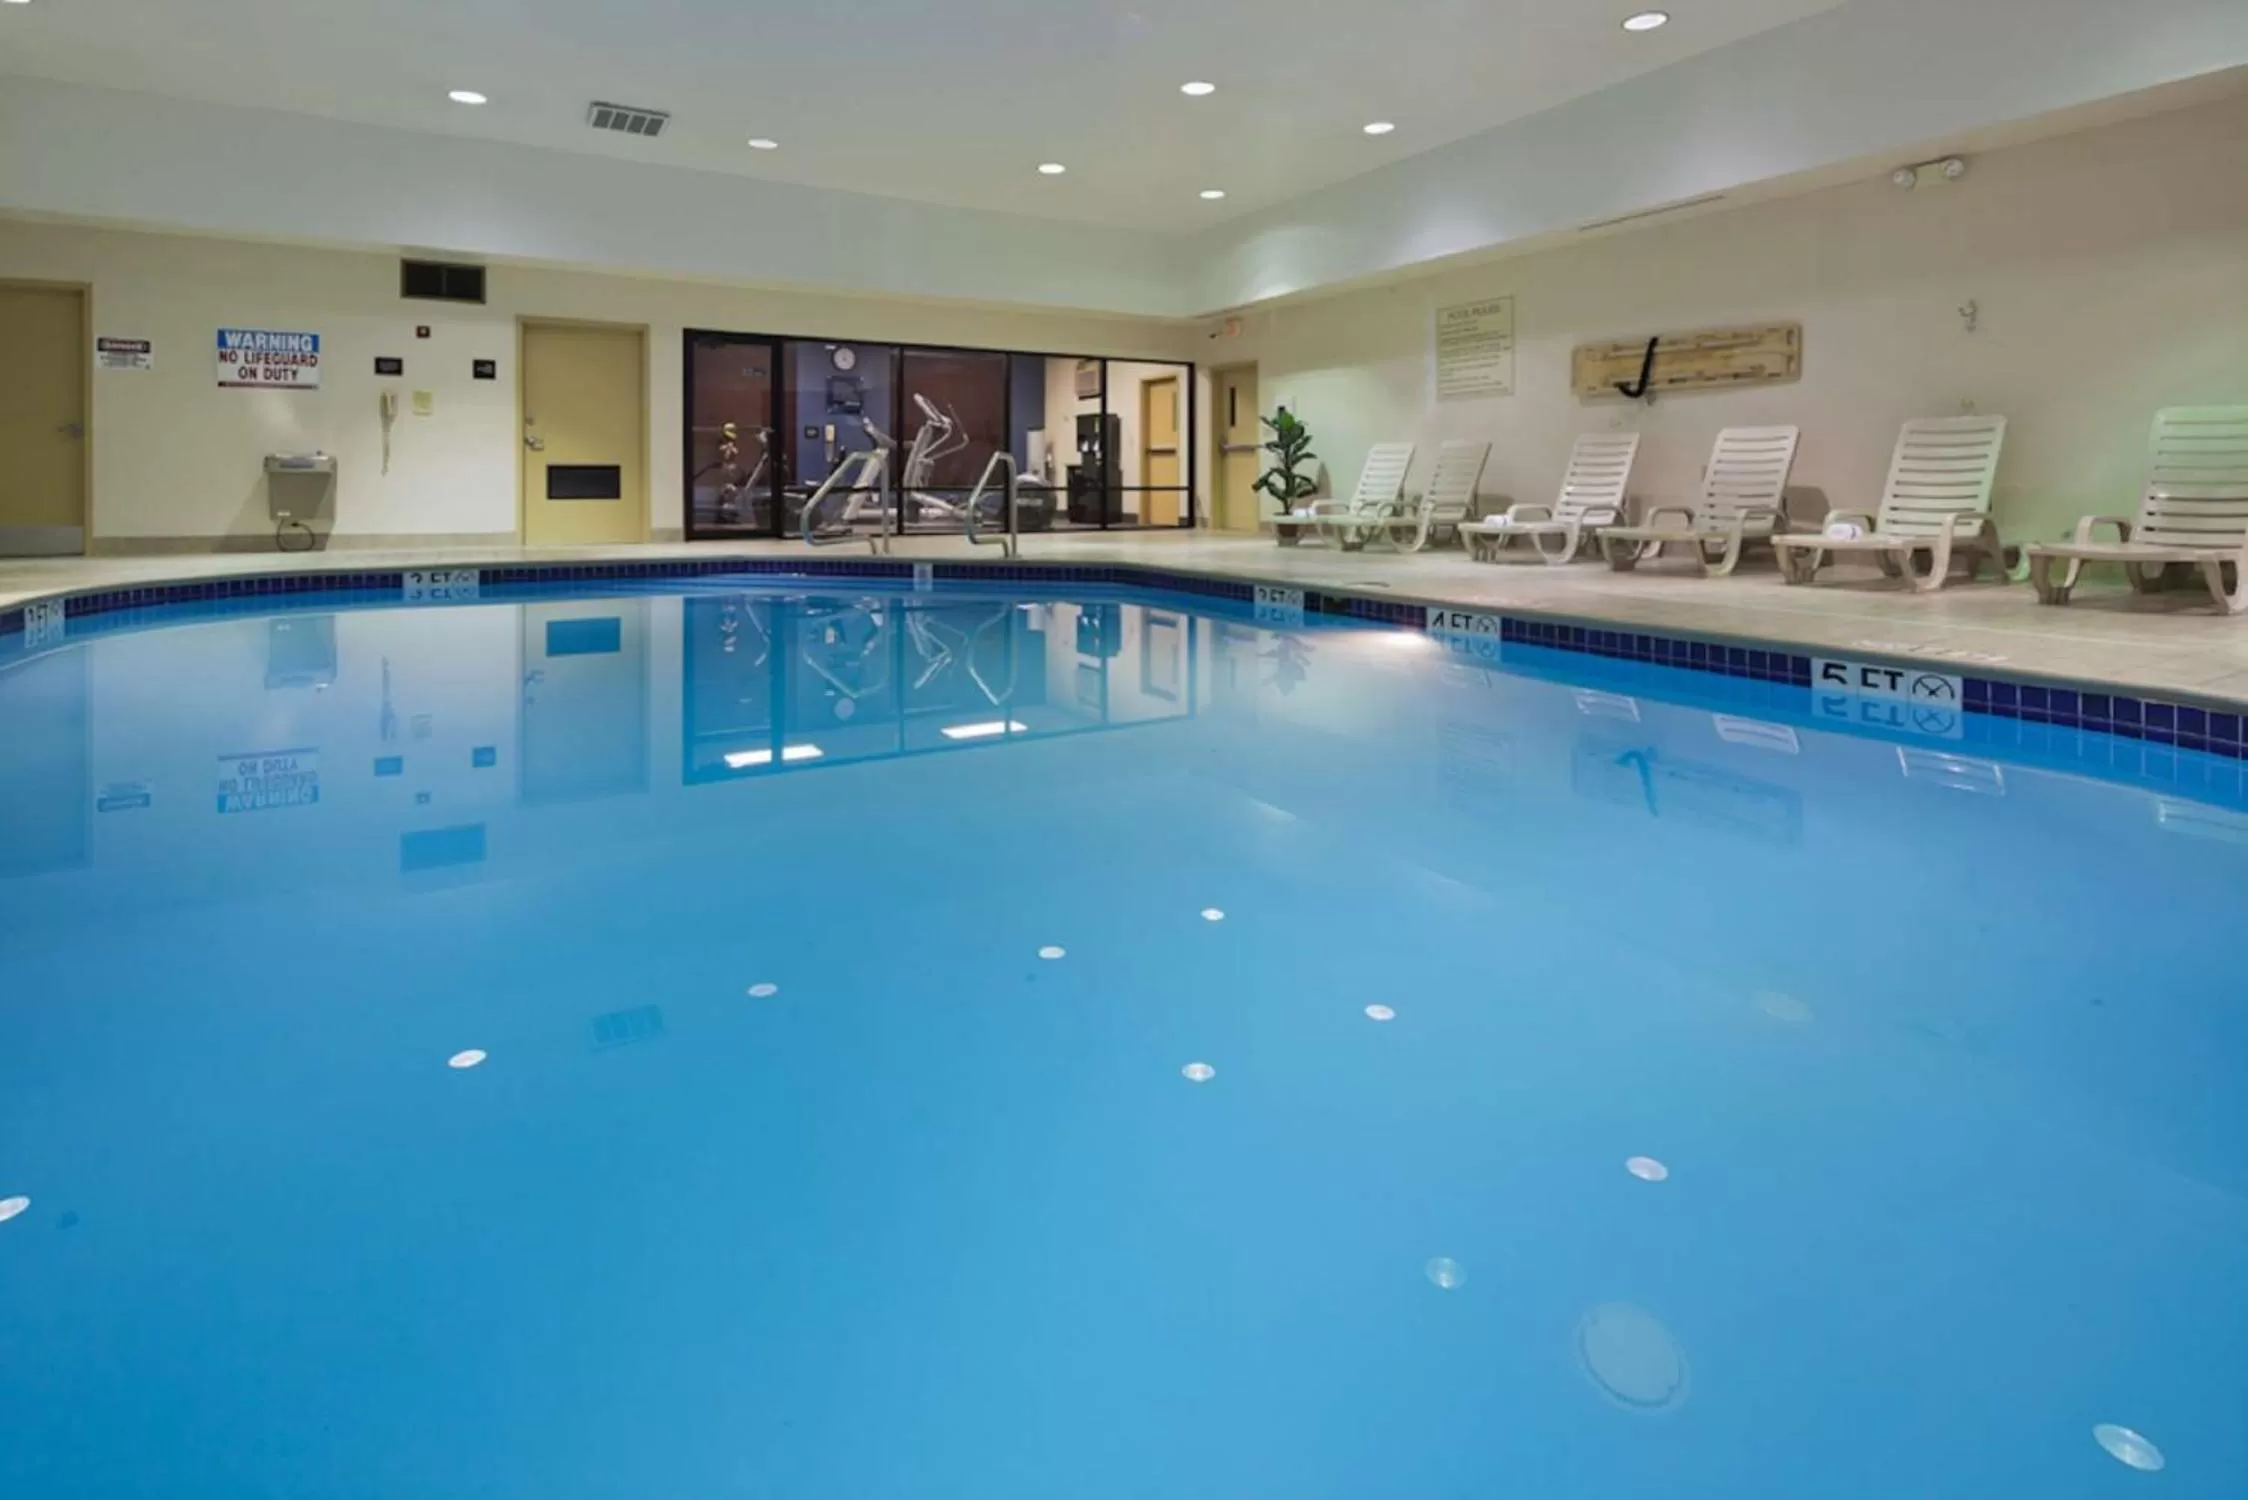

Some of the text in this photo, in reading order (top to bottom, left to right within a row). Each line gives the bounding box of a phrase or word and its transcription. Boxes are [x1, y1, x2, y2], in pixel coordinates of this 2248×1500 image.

[224, 331, 313, 352] WARNING
[219, 350, 318, 368] NO LIFEGUARD
[238, 366, 298, 381] ON DUTY
[1823, 662, 1904, 691] 5 FT
